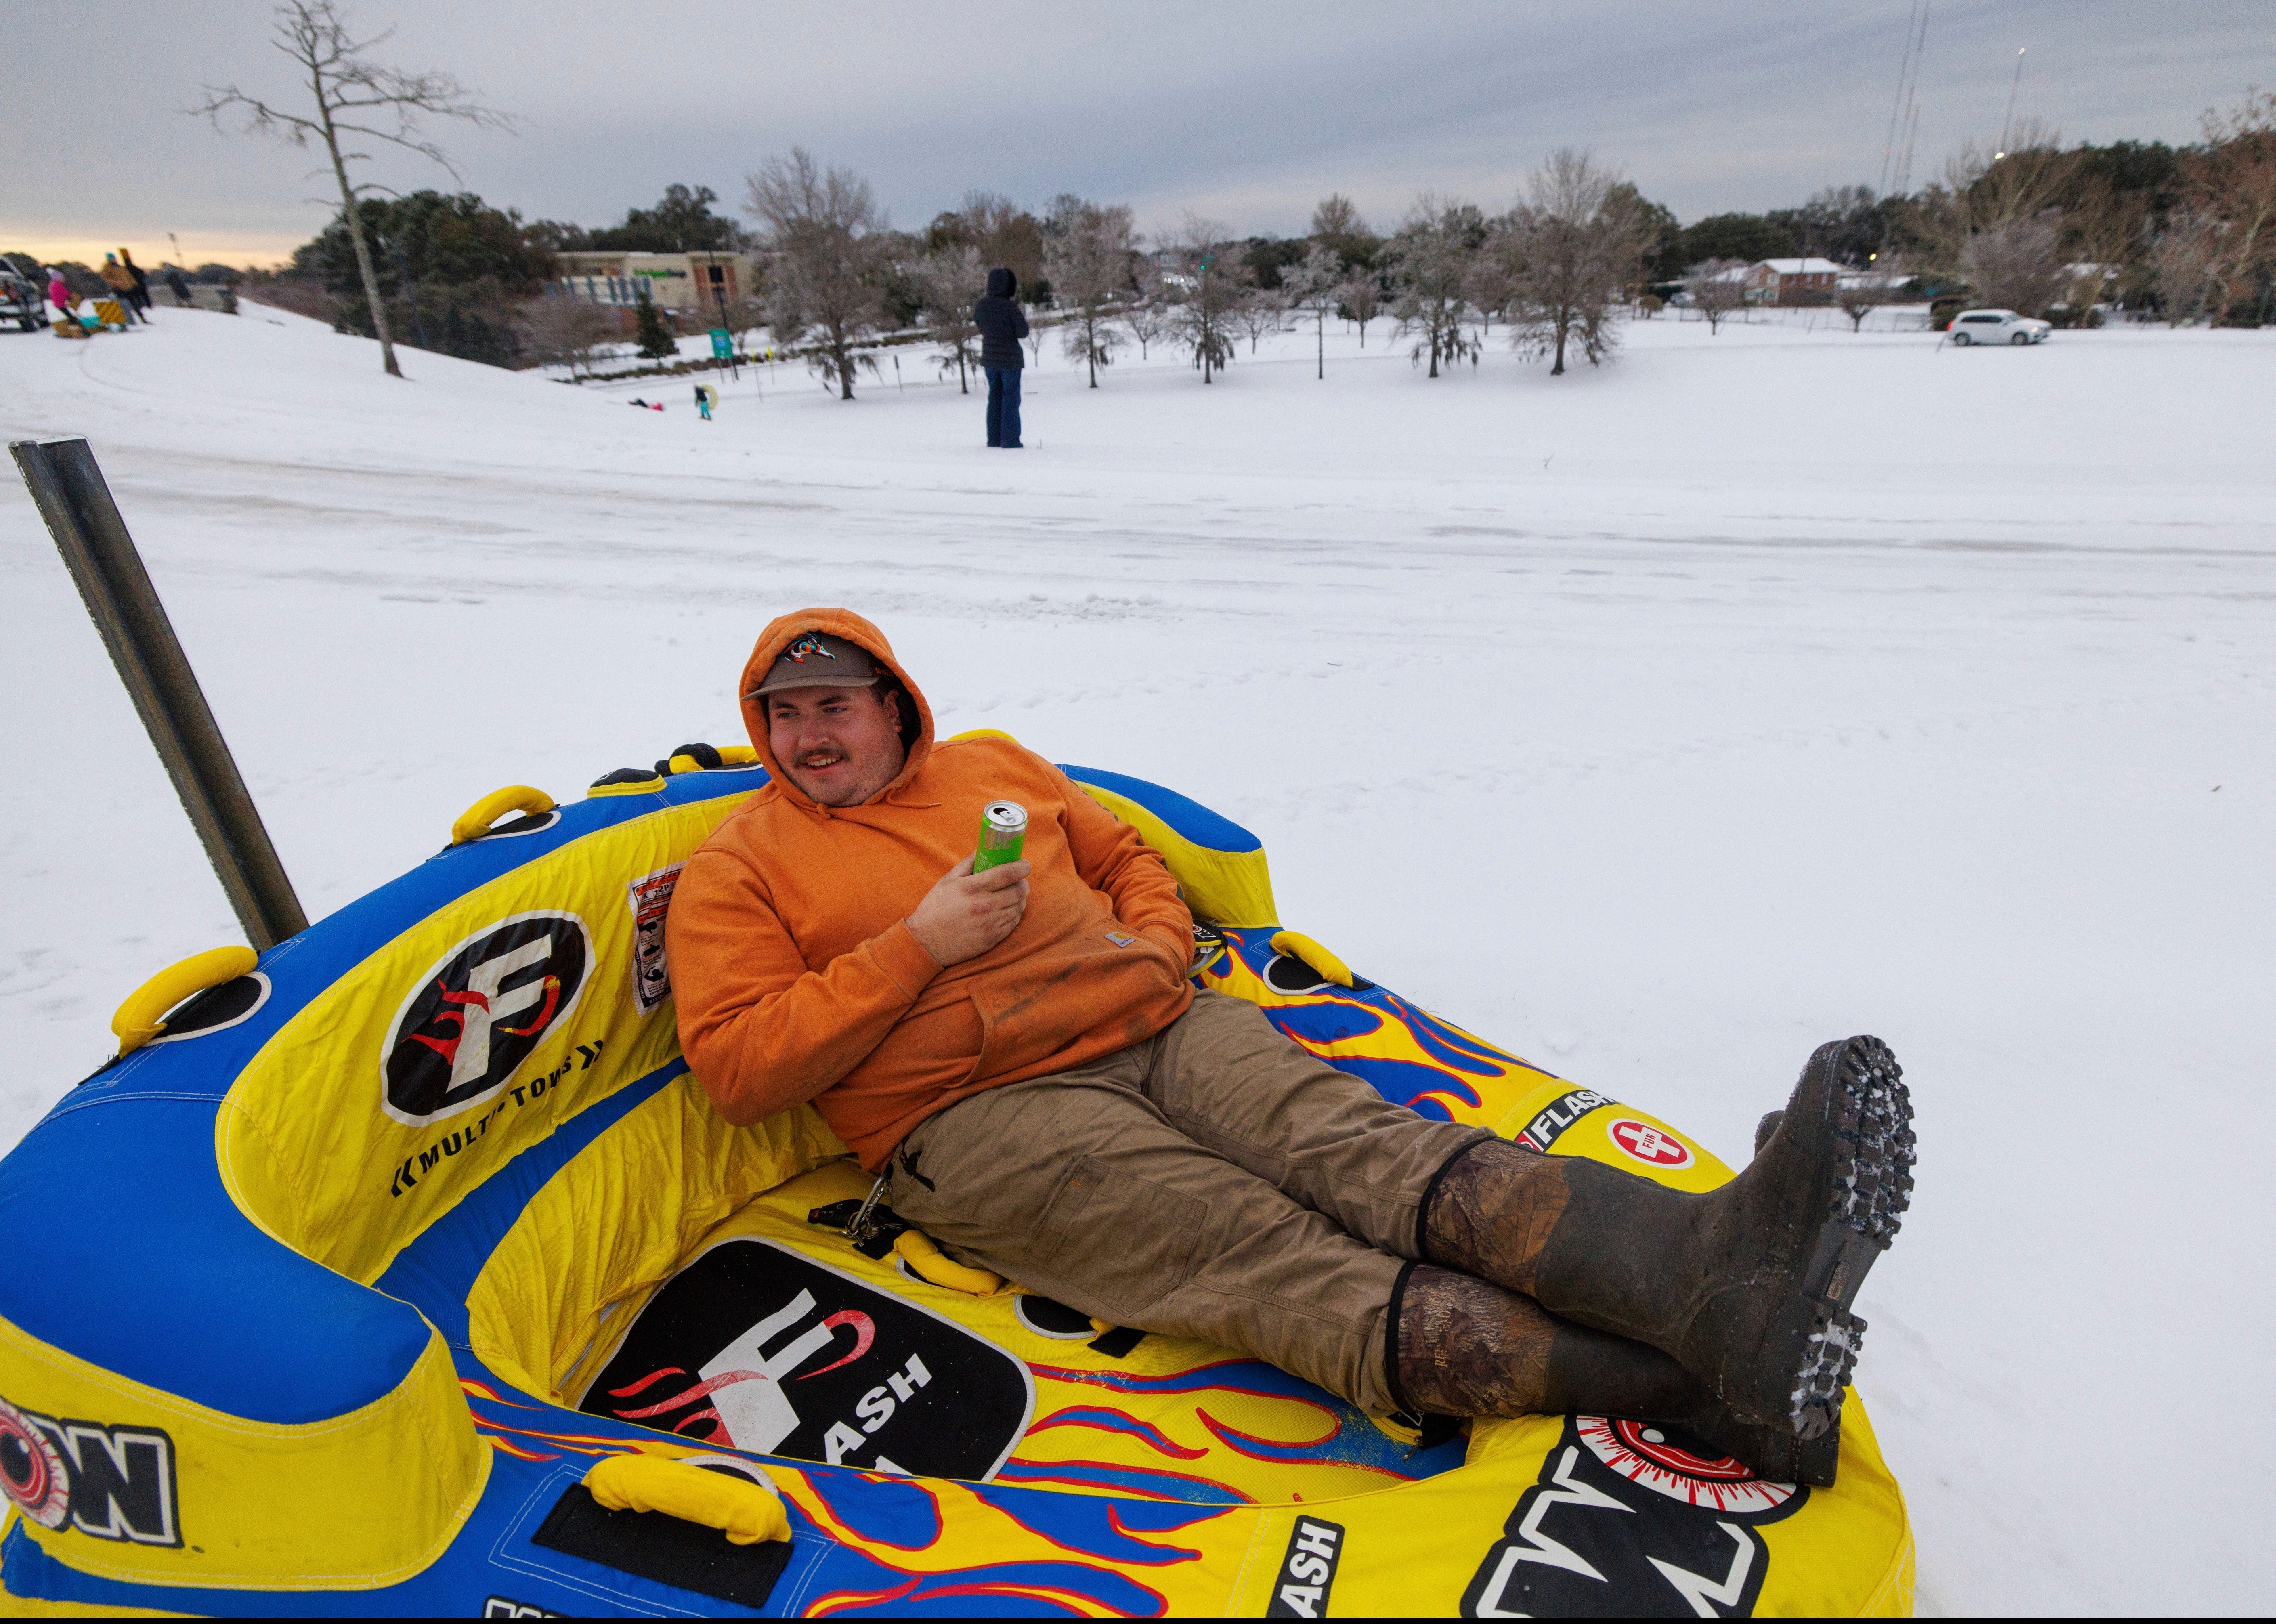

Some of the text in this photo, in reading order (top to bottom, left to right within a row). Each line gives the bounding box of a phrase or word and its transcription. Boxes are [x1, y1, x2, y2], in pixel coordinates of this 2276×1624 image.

[1530, 1091, 1615, 1144] FLASH
[1642, 1133, 1656, 1149] FUN
[1435, 1311, 1452, 1368] READ
[824, 1353, 932, 1466] ASH
[1280, 1522, 1338, 1618] ASH
